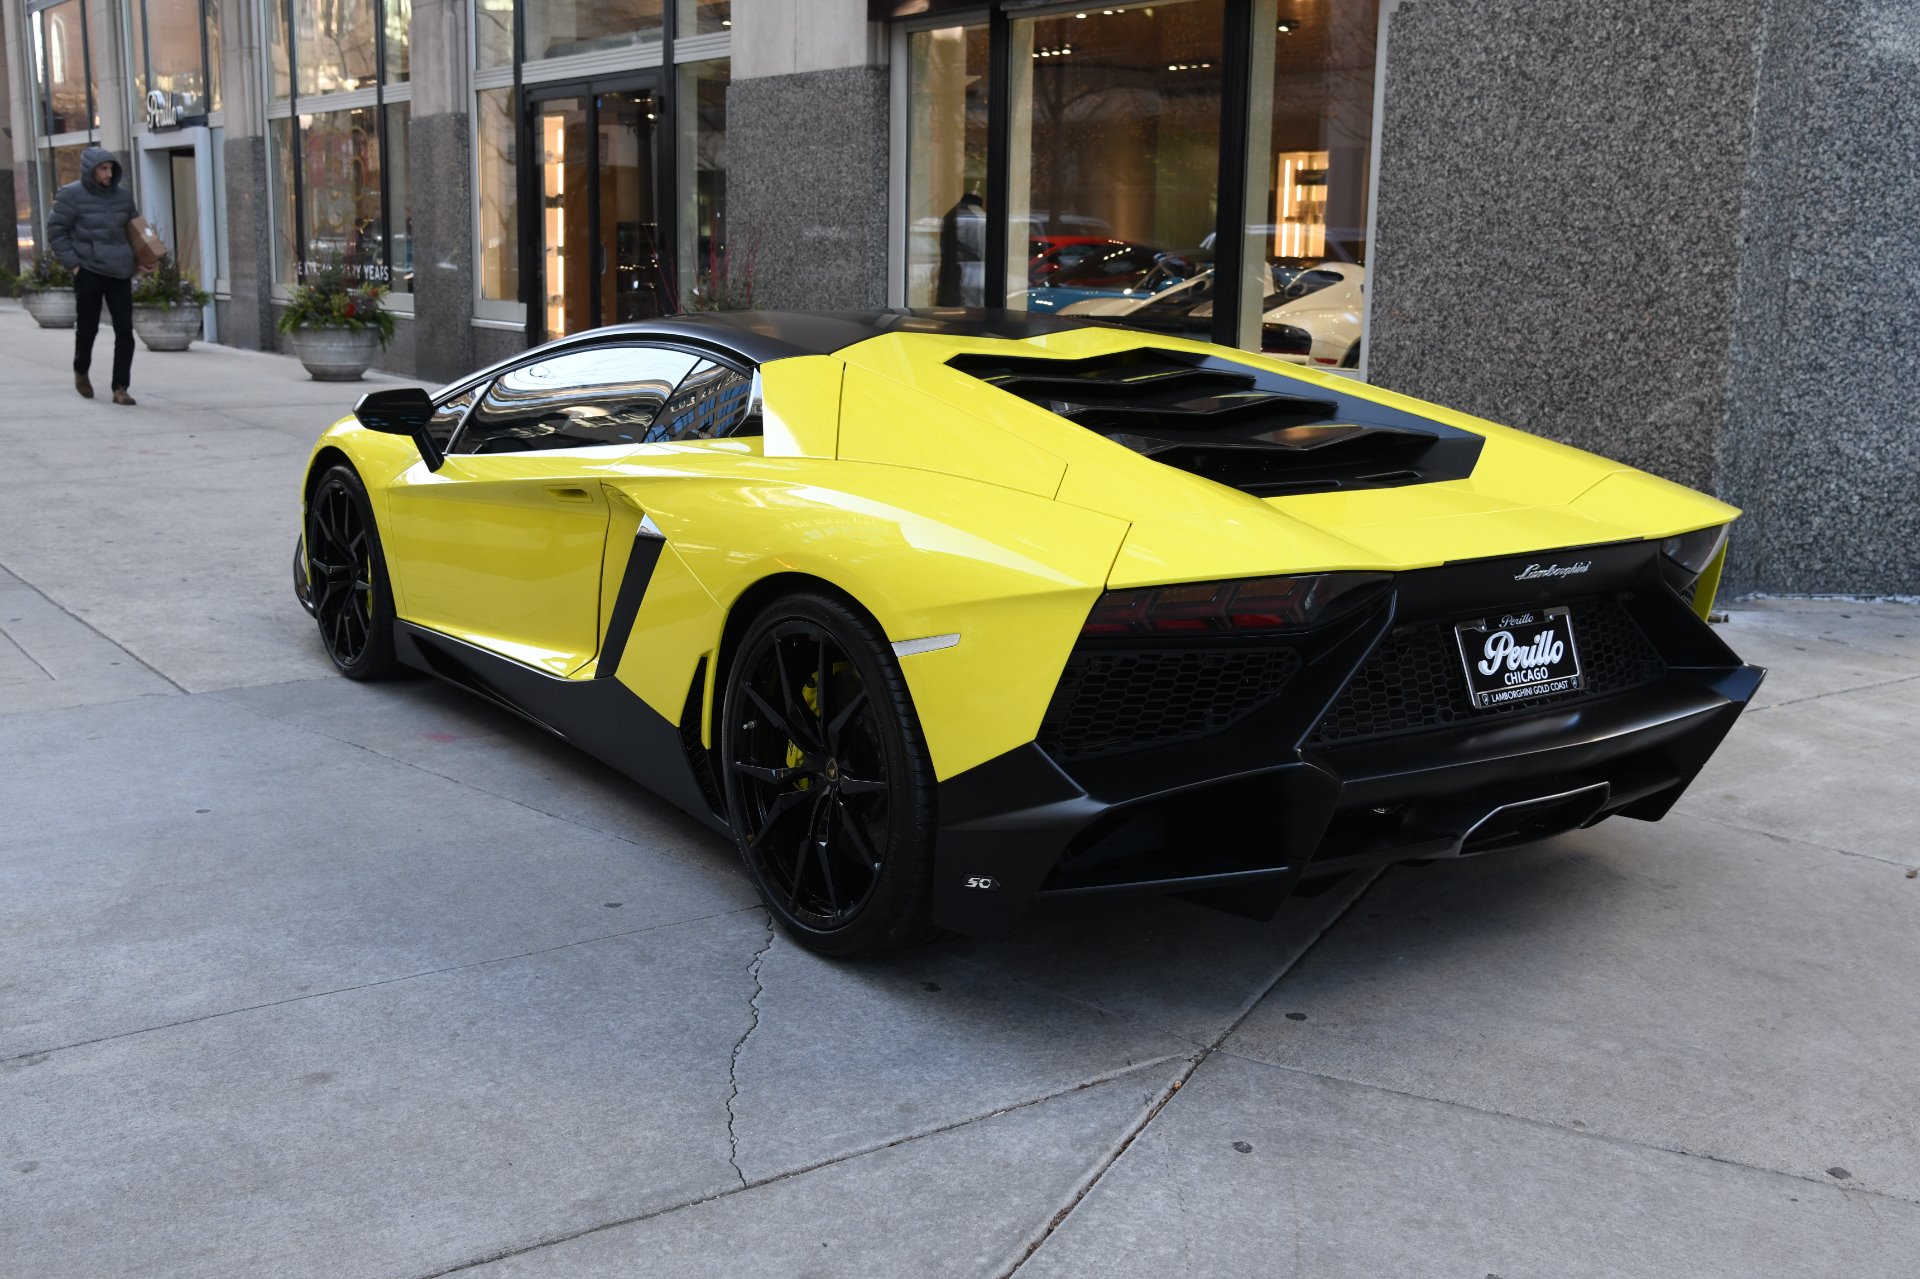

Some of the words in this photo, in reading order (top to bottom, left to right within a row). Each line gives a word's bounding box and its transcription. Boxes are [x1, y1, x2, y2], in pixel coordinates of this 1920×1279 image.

[147, 90, 179, 129] Perillo
[1514, 560, 1592, 581] Lamborghini
[1499, 613, 1534, 628] Perillo
[1478, 629, 1564, 676] Perillo
[1504, 666, 1549, 685] CHICAGO
[1491, 687, 1533, 703] LAMBORGHINI
[1533, 683, 1550, 695] GOLD
[1550, 680, 1569, 691] COAST
